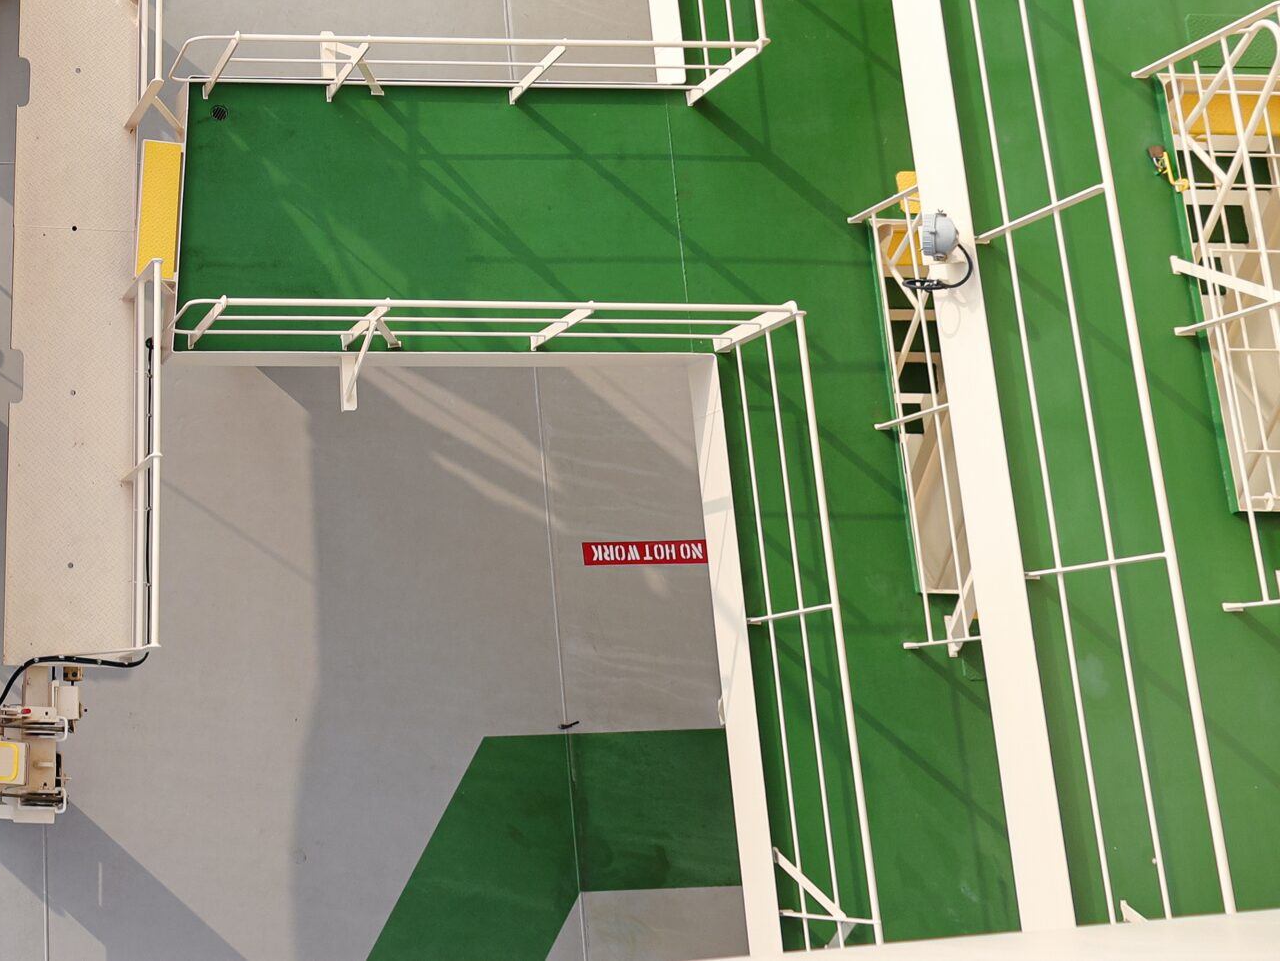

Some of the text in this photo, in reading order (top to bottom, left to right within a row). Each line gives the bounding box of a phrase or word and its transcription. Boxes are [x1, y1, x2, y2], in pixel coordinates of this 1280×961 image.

[591, 542, 704, 561] NO HOT WORK
